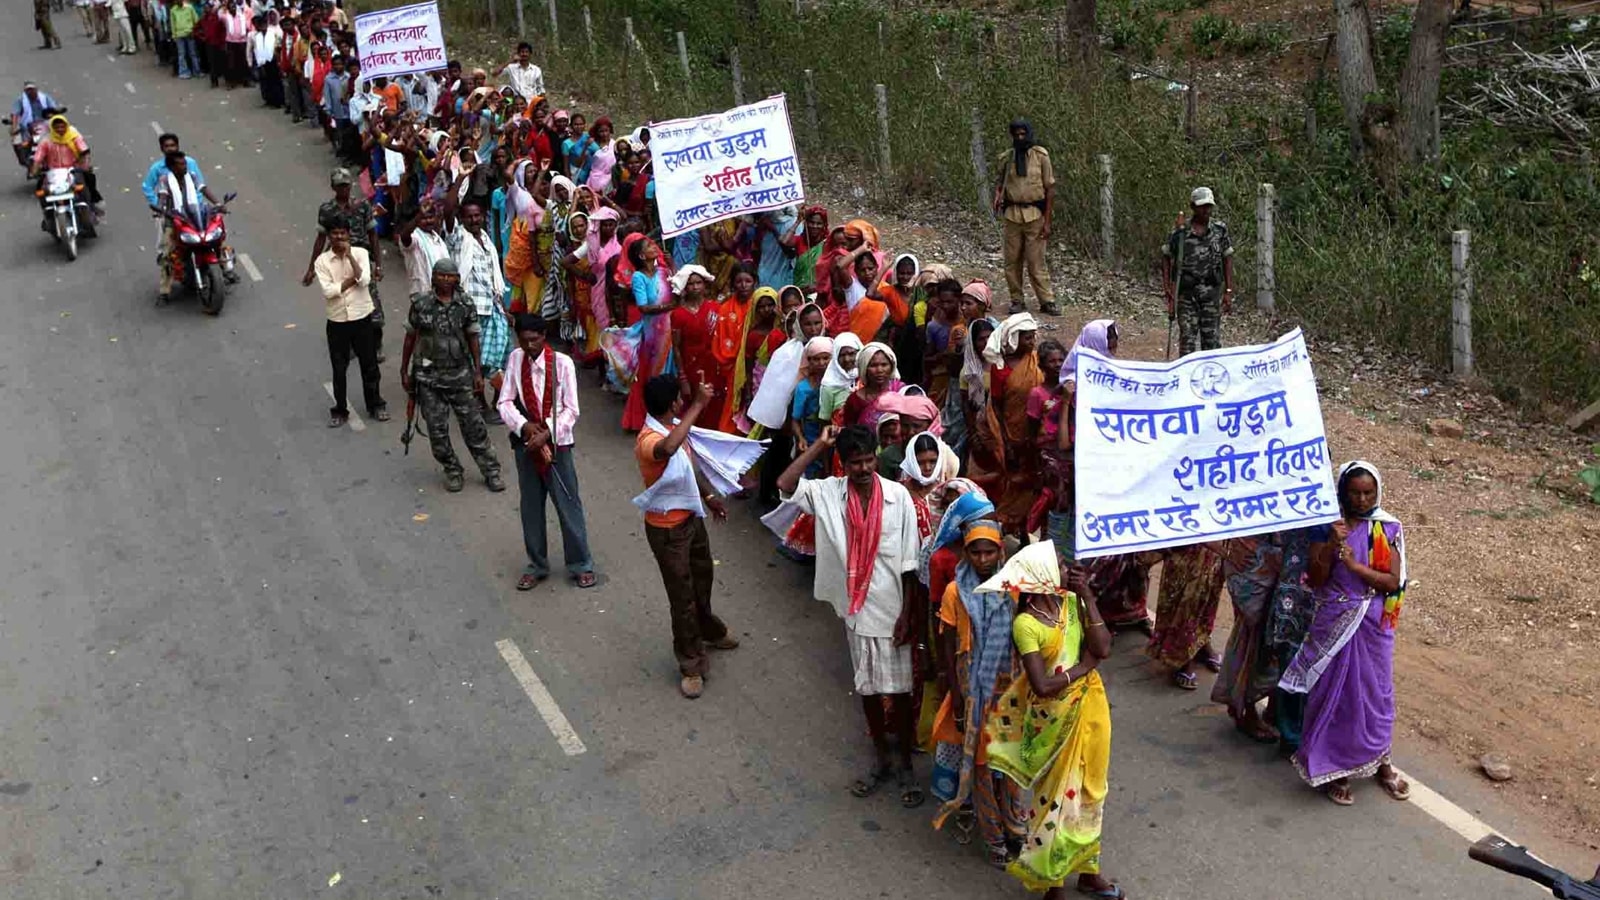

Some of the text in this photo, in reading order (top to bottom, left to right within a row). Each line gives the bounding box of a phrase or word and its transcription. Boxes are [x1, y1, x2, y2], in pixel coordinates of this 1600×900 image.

[661, 141, 713, 172] सलवा
[703, 156, 795, 192] शहीद दिवस
[673, 203, 711, 228] अमर
[742, 188, 782, 208] अमर
[1091, 390, 1293, 444] सलवा जुडूम
[1173, 436, 1325, 491] शहीद दिवस
[1081, 512, 1159, 542] अमर
[1154, 495, 1204, 534] रहे
[1209, 491, 1282, 526] अमर
